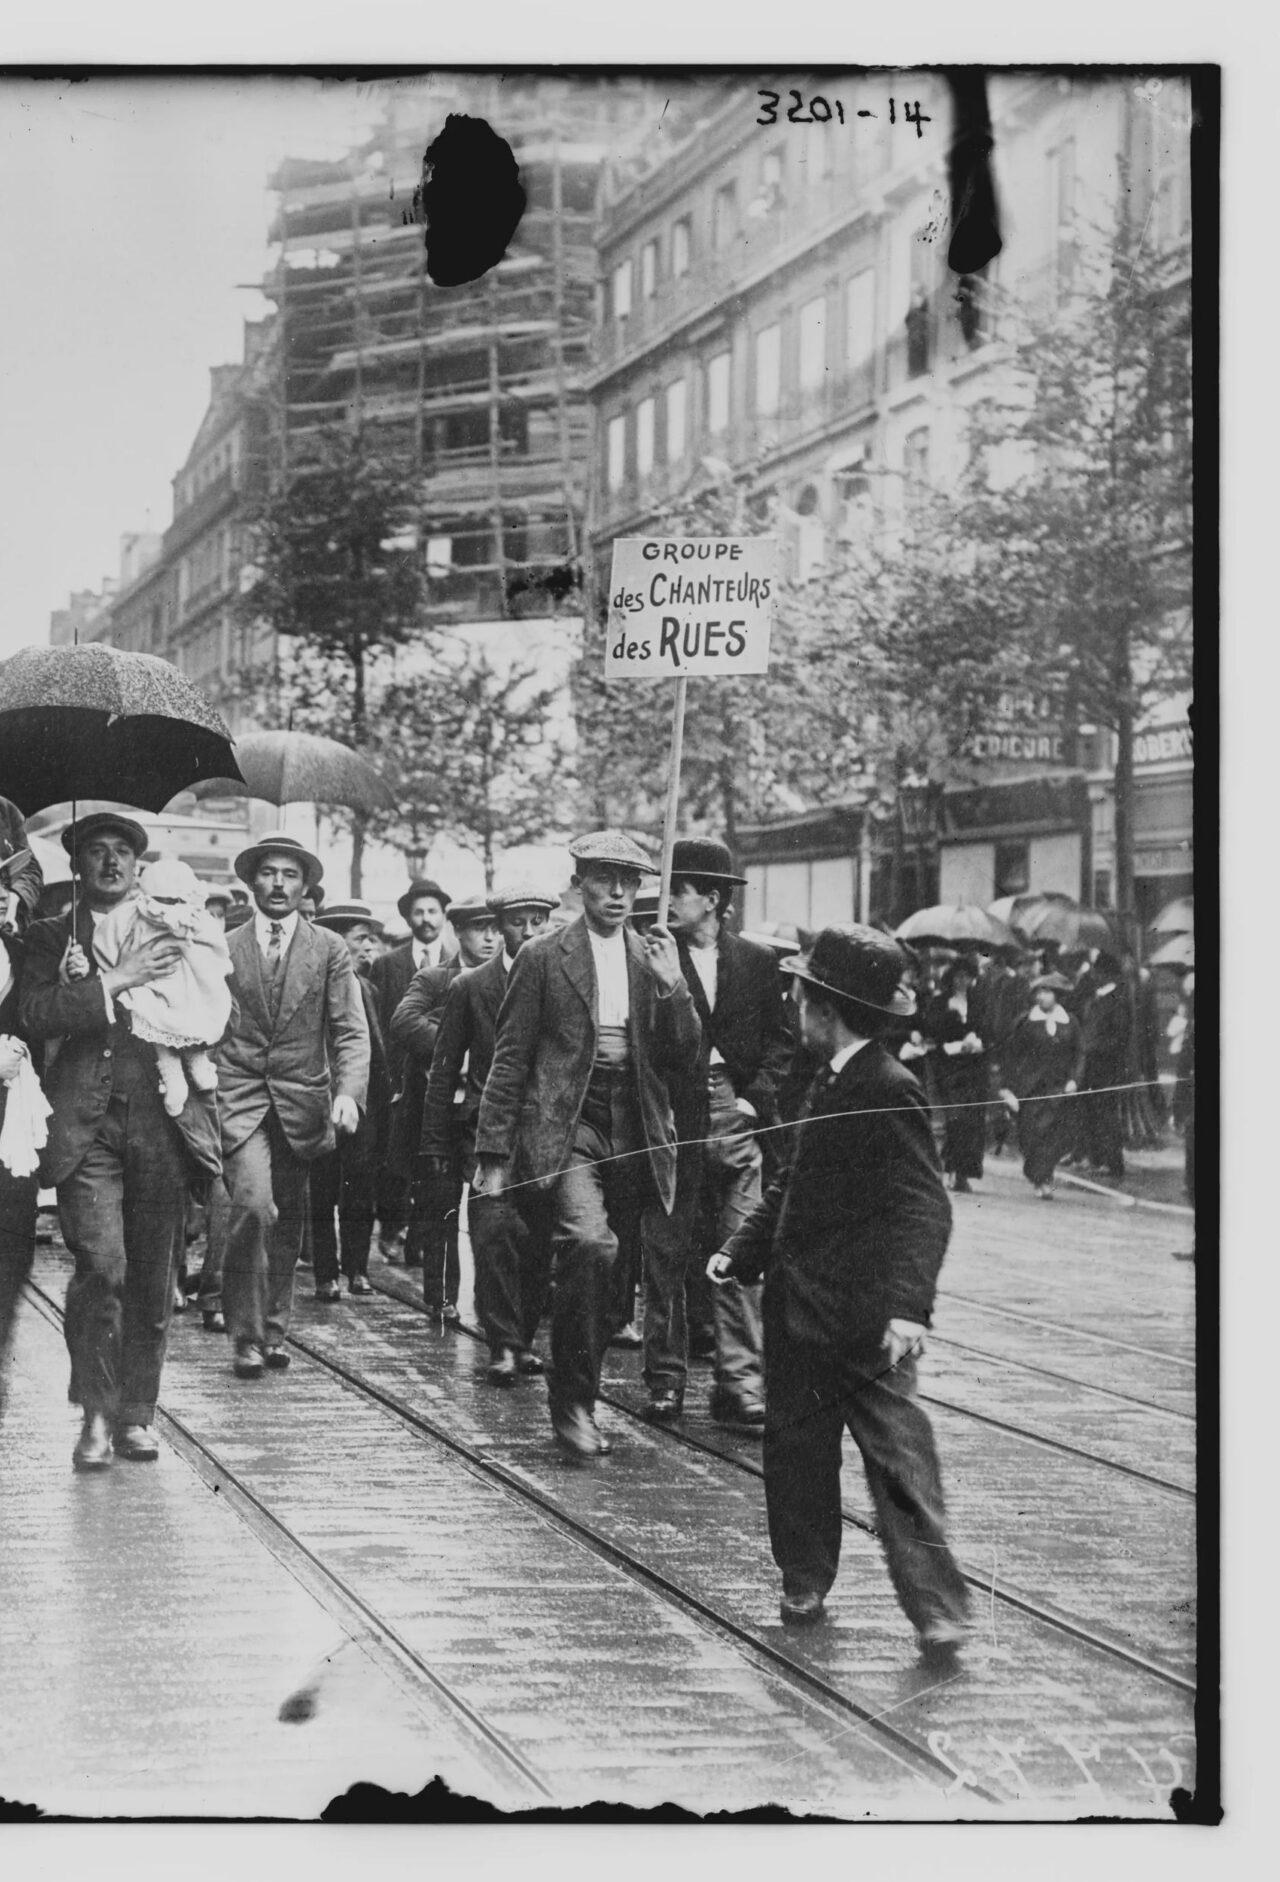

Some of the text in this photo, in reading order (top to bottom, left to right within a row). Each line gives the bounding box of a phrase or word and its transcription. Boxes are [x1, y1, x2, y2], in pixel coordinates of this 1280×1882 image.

[642, 542, 744, 565] GROUPE
[613, 571, 771, 612] des CHANTEURS
[612, 616, 746, 667] des RUES
